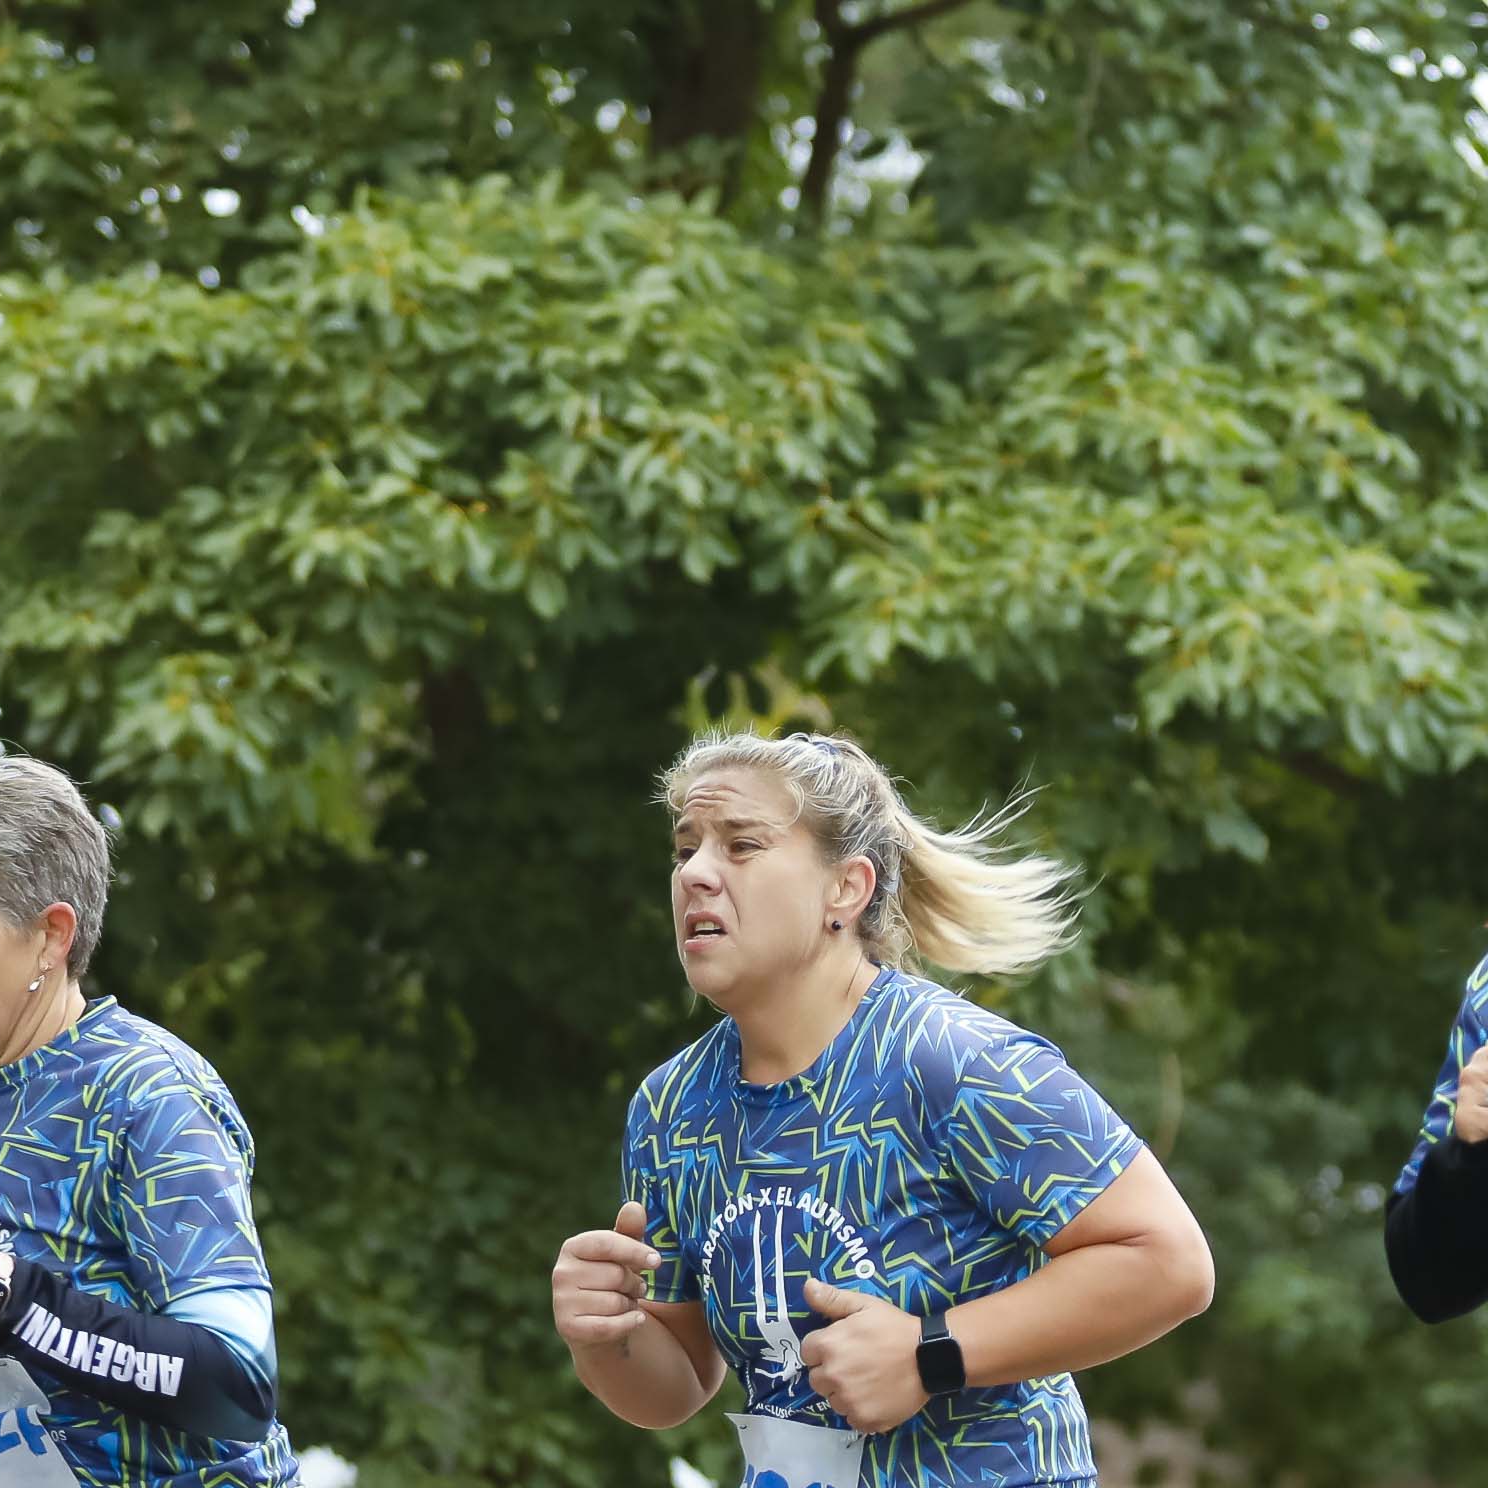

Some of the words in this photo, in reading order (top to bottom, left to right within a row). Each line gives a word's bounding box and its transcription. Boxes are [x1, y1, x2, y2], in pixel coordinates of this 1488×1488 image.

[701, 1192, 754, 1295] MARATÓN
[758, 1187, 772, 1208] X
[775, 1186, 793, 1207] EL
[796, 1192, 876, 1280] AUTISMO
